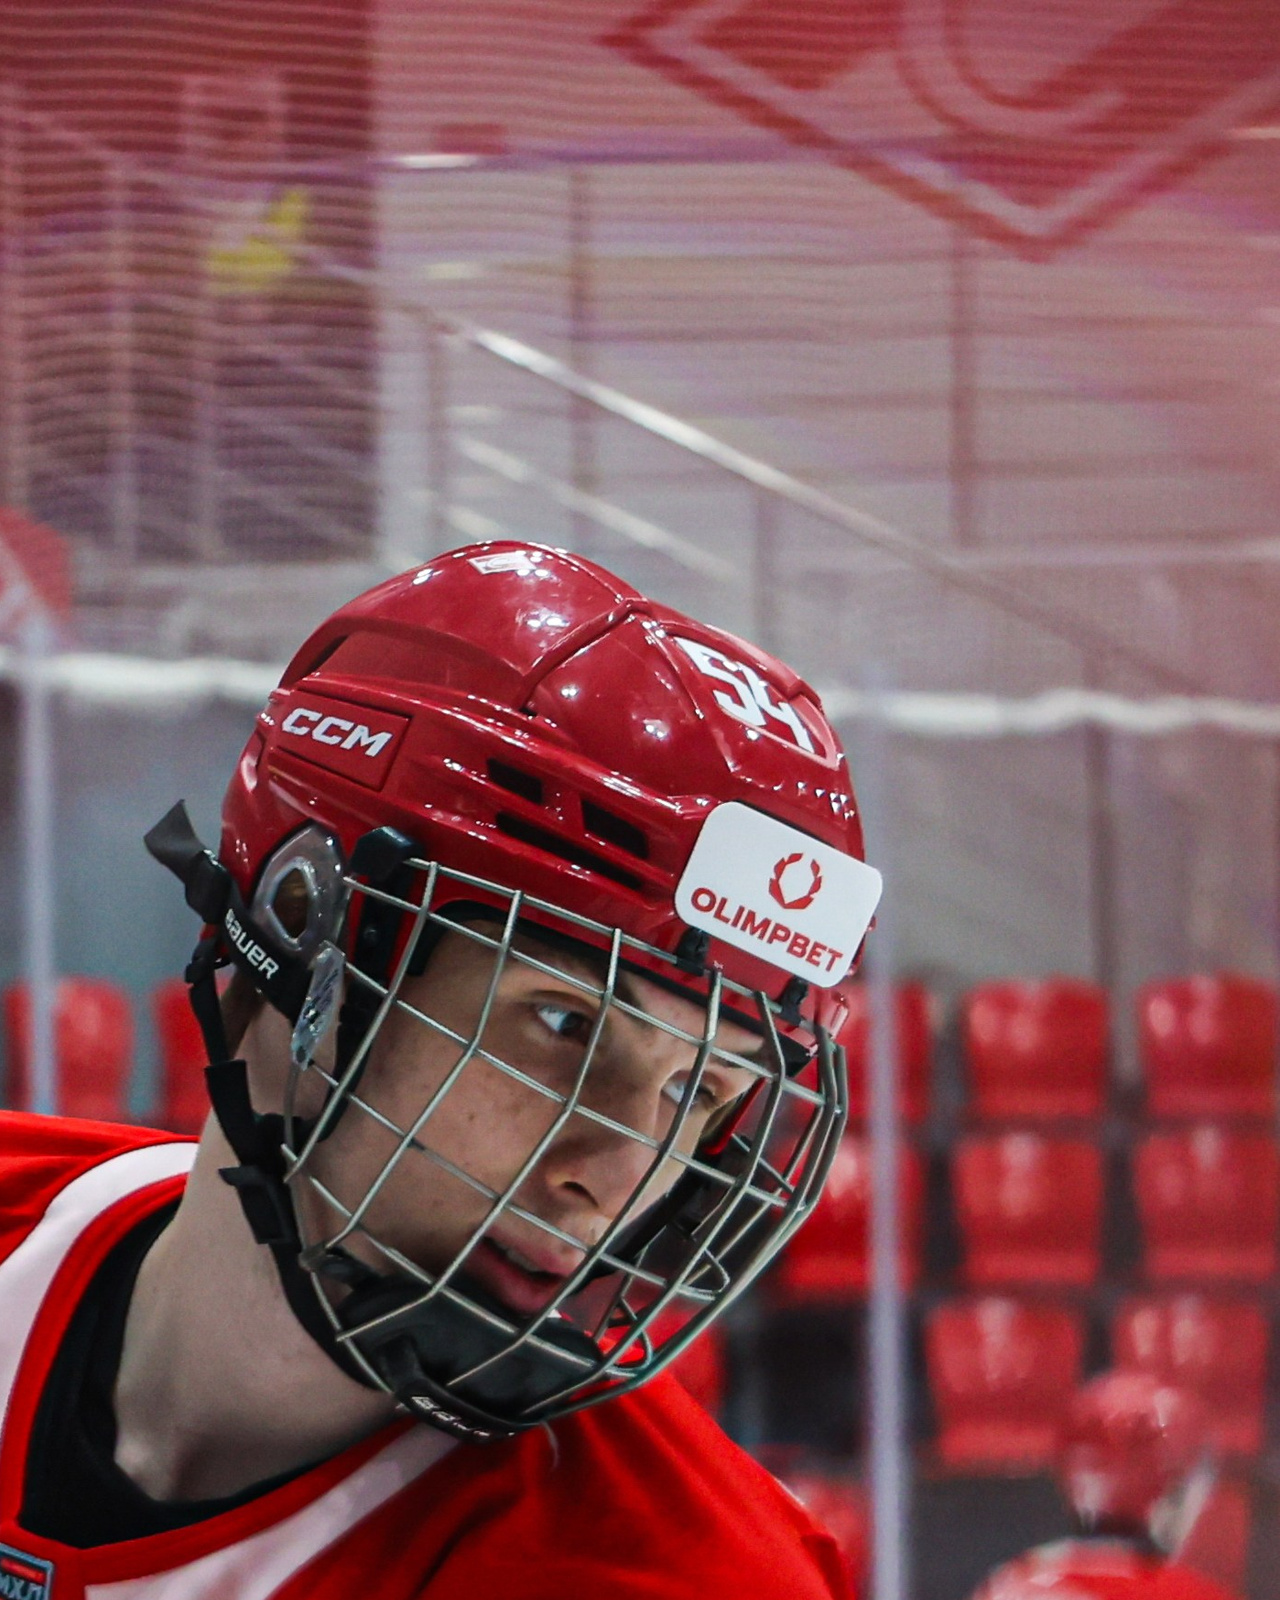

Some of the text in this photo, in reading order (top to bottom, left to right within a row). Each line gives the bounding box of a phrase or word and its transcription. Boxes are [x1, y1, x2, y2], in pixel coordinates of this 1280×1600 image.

[282, 707, 393, 757] CCM
[674, 636, 815, 755] 54
[225, 908, 280, 980] BAUER
[690, 887, 844, 973] OLIMPBET
